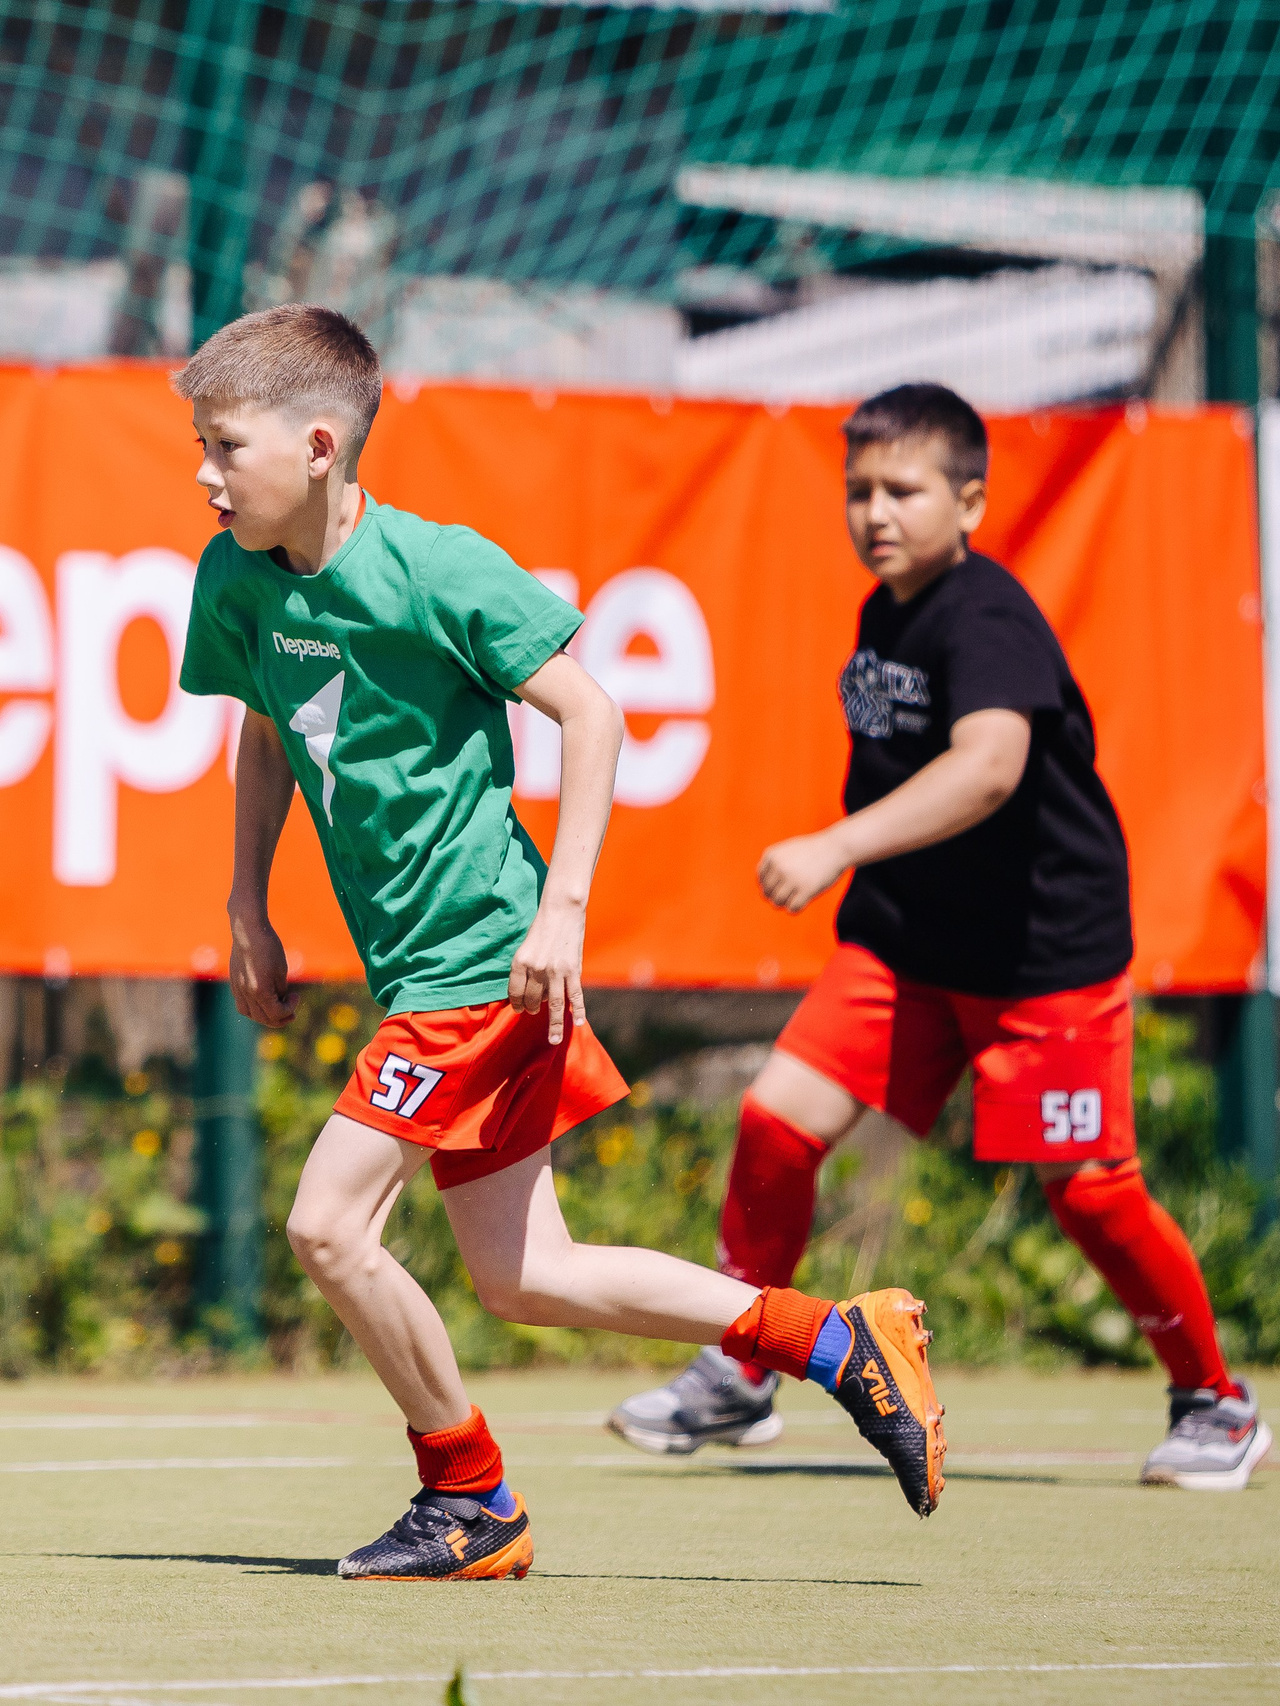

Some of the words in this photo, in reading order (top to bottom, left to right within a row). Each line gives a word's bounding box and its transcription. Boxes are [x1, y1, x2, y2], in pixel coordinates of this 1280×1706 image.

[272, 631, 342, 662] Первые
[370, 1052, 447, 1119] 57
[1041, 1087, 1102, 1144] 59
[861, 1357, 898, 1417] FILA
